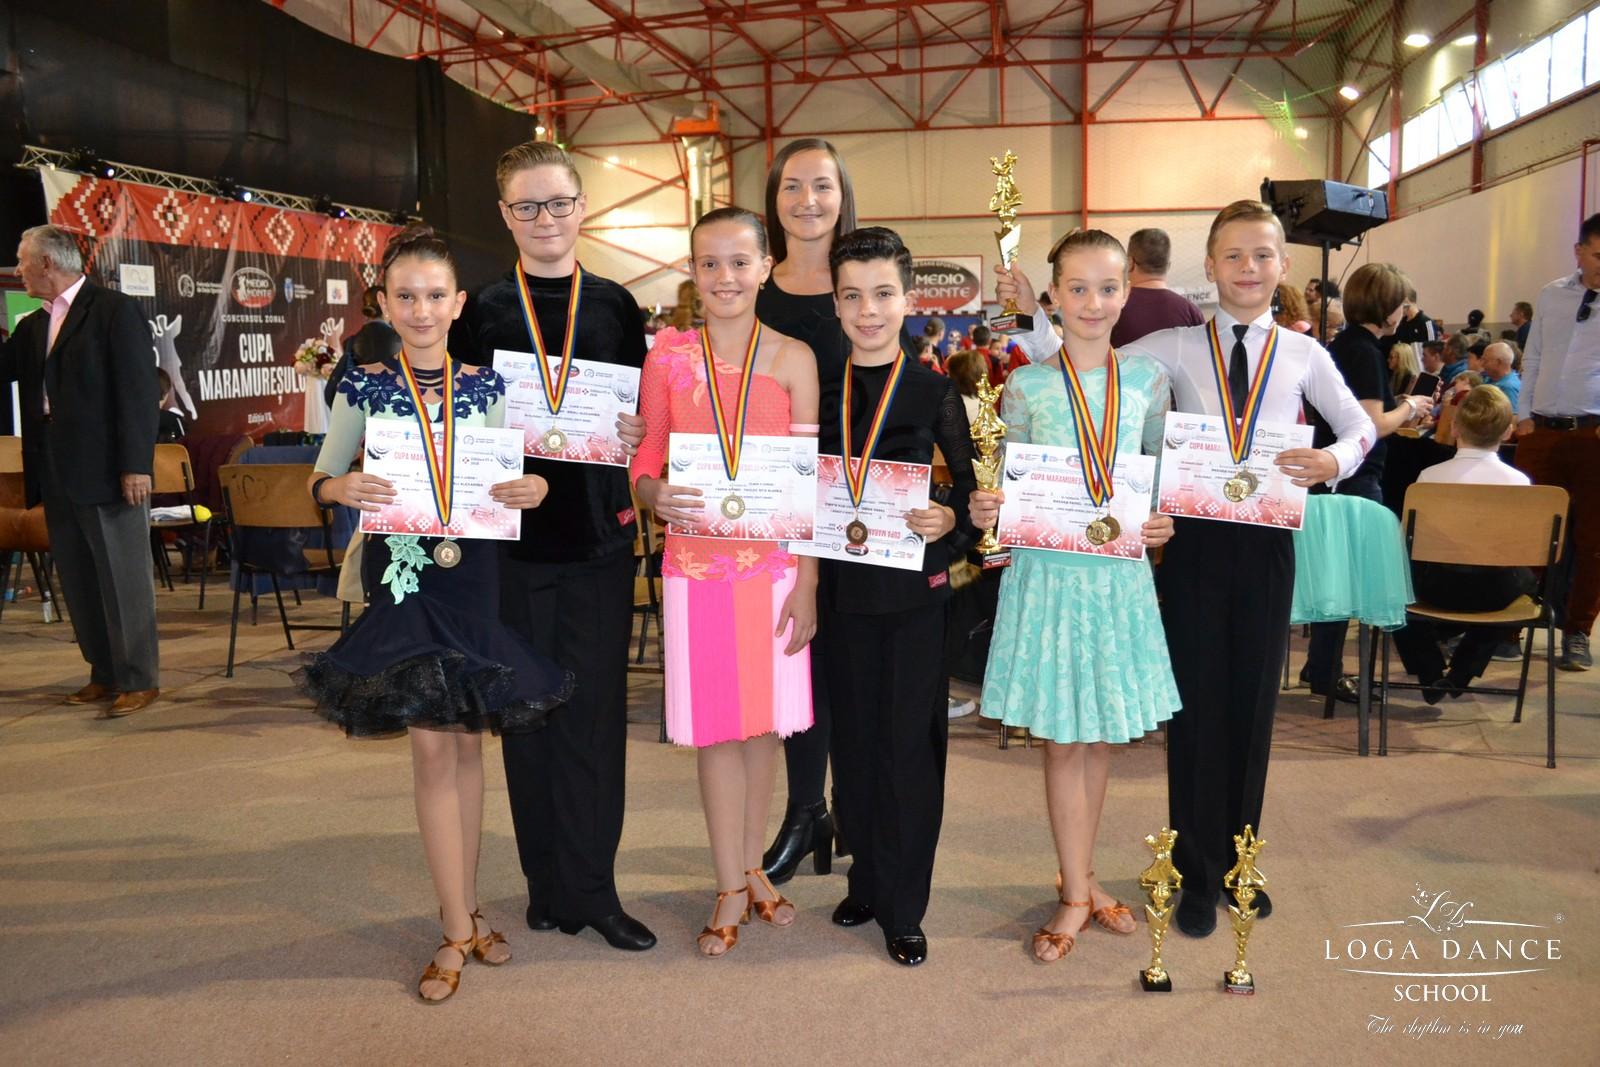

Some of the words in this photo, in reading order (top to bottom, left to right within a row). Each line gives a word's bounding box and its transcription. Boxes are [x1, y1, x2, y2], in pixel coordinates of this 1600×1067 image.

[246, 279, 269, 288] MEDIO
[915, 273, 965, 286] MEDIO
[246, 289, 272, 298] MONTE
[915, 287, 971, 299] MONTE
[221, 314, 263, 324] CONCURSUL
[265, 315, 285, 324] ZONAL
[239, 333, 274, 363] CUPA
